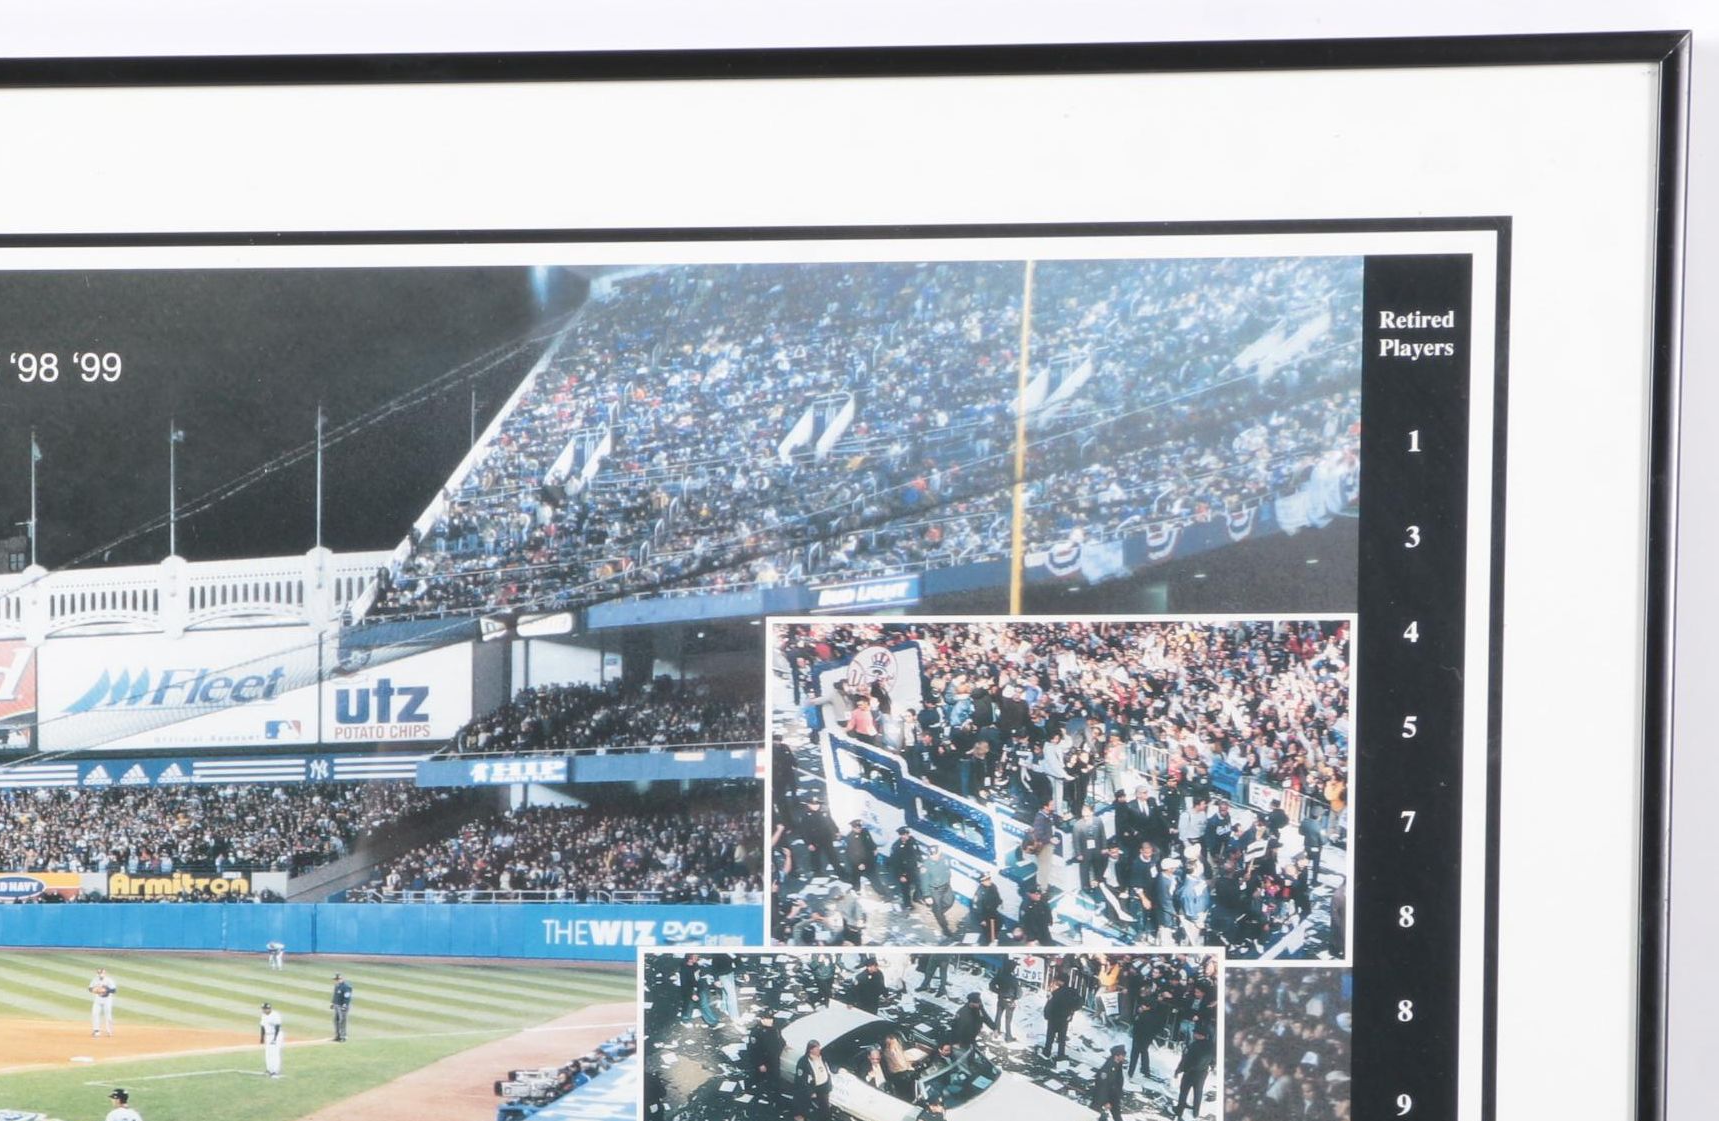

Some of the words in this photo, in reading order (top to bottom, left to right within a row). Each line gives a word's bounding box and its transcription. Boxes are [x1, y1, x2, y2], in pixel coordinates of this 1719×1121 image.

[1379, 310, 1455, 329] Retired
[1379, 338, 1454, 361] Players
[11, 353, 58, 382] '98
[73, 352, 121, 382] '99
[1408, 430, 1421, 452] 1
[1405, 525, 1421, 548] 3
[1403, 620, 1420, 643] 4
[150, 665, 287, 706] Fleet
[335, 677, 430, 724] utz
[334, 726, 387, 739] POTATO
[389, 724, 431, 739] CHIPS
[1401, 715, 1417, 739] 5
[1400, 810, 1416, 833] 7
[9, 881, 39, 893] NAVY
[109, 872, 249, 897] Armitron
[1398, 905, 1415, 928] 8
[1397, 999, 1414, 1022] 8
[1396, 1093, 1412, 1116] 9
